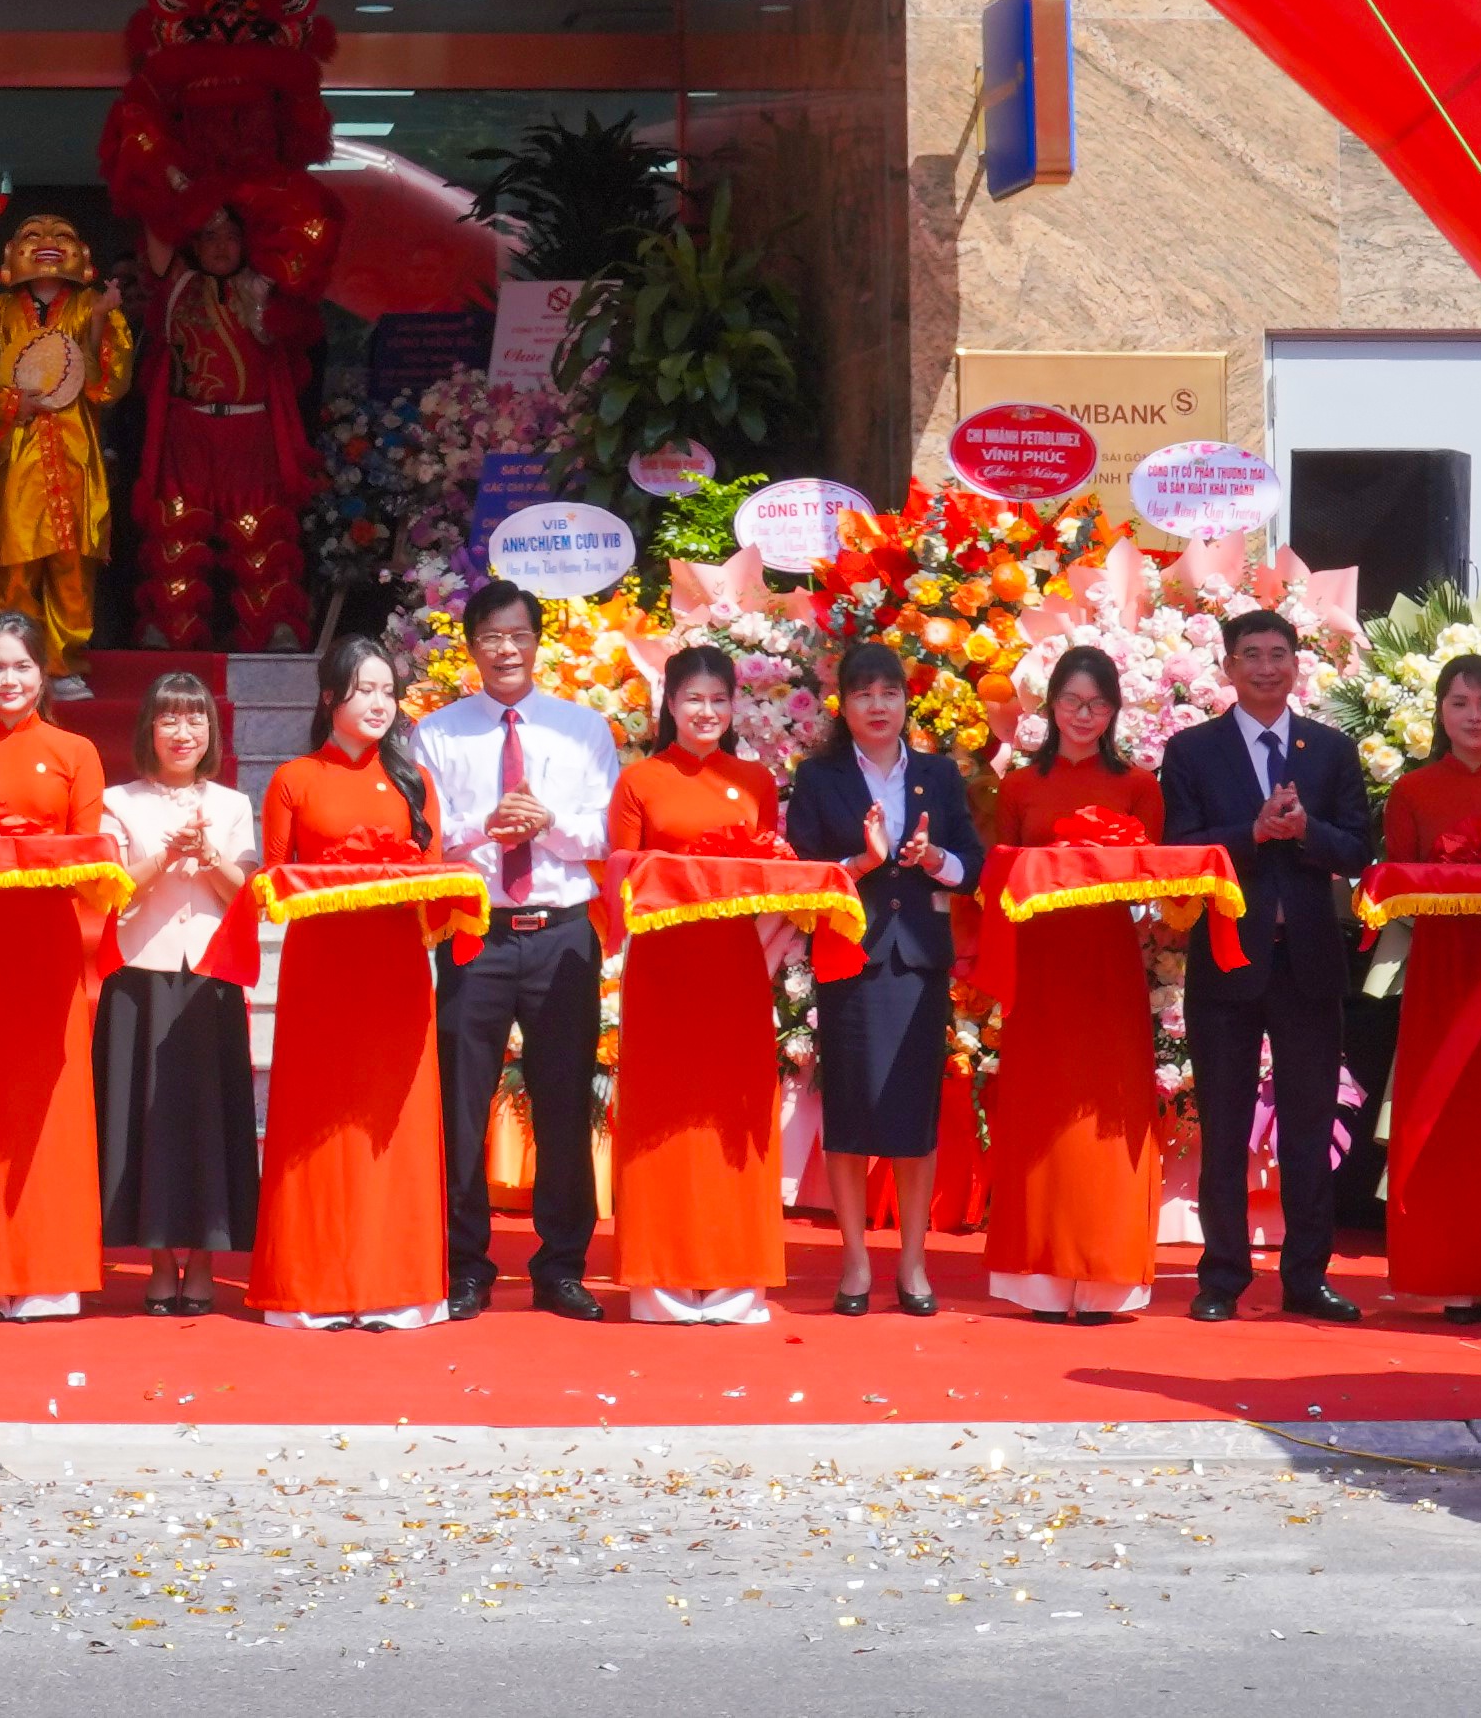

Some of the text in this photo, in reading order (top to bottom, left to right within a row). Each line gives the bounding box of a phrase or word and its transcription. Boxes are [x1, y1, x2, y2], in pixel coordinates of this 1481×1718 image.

[966, 428, 983, 443] CHI
[1020, 430, 1081, 448] PETROLIMEX
[981, 446, 1067, 465] VĨNH PHÚC
[1148, 463, 1169, 478] CÔNG
[1171, 465, 1180, 479] TY
[757, 501, 798, 519] CÔNG
[802, 502, 819, 515] TY
[542, 519, 568, 530] VIB
[602, 532, 622, 548] VIB
